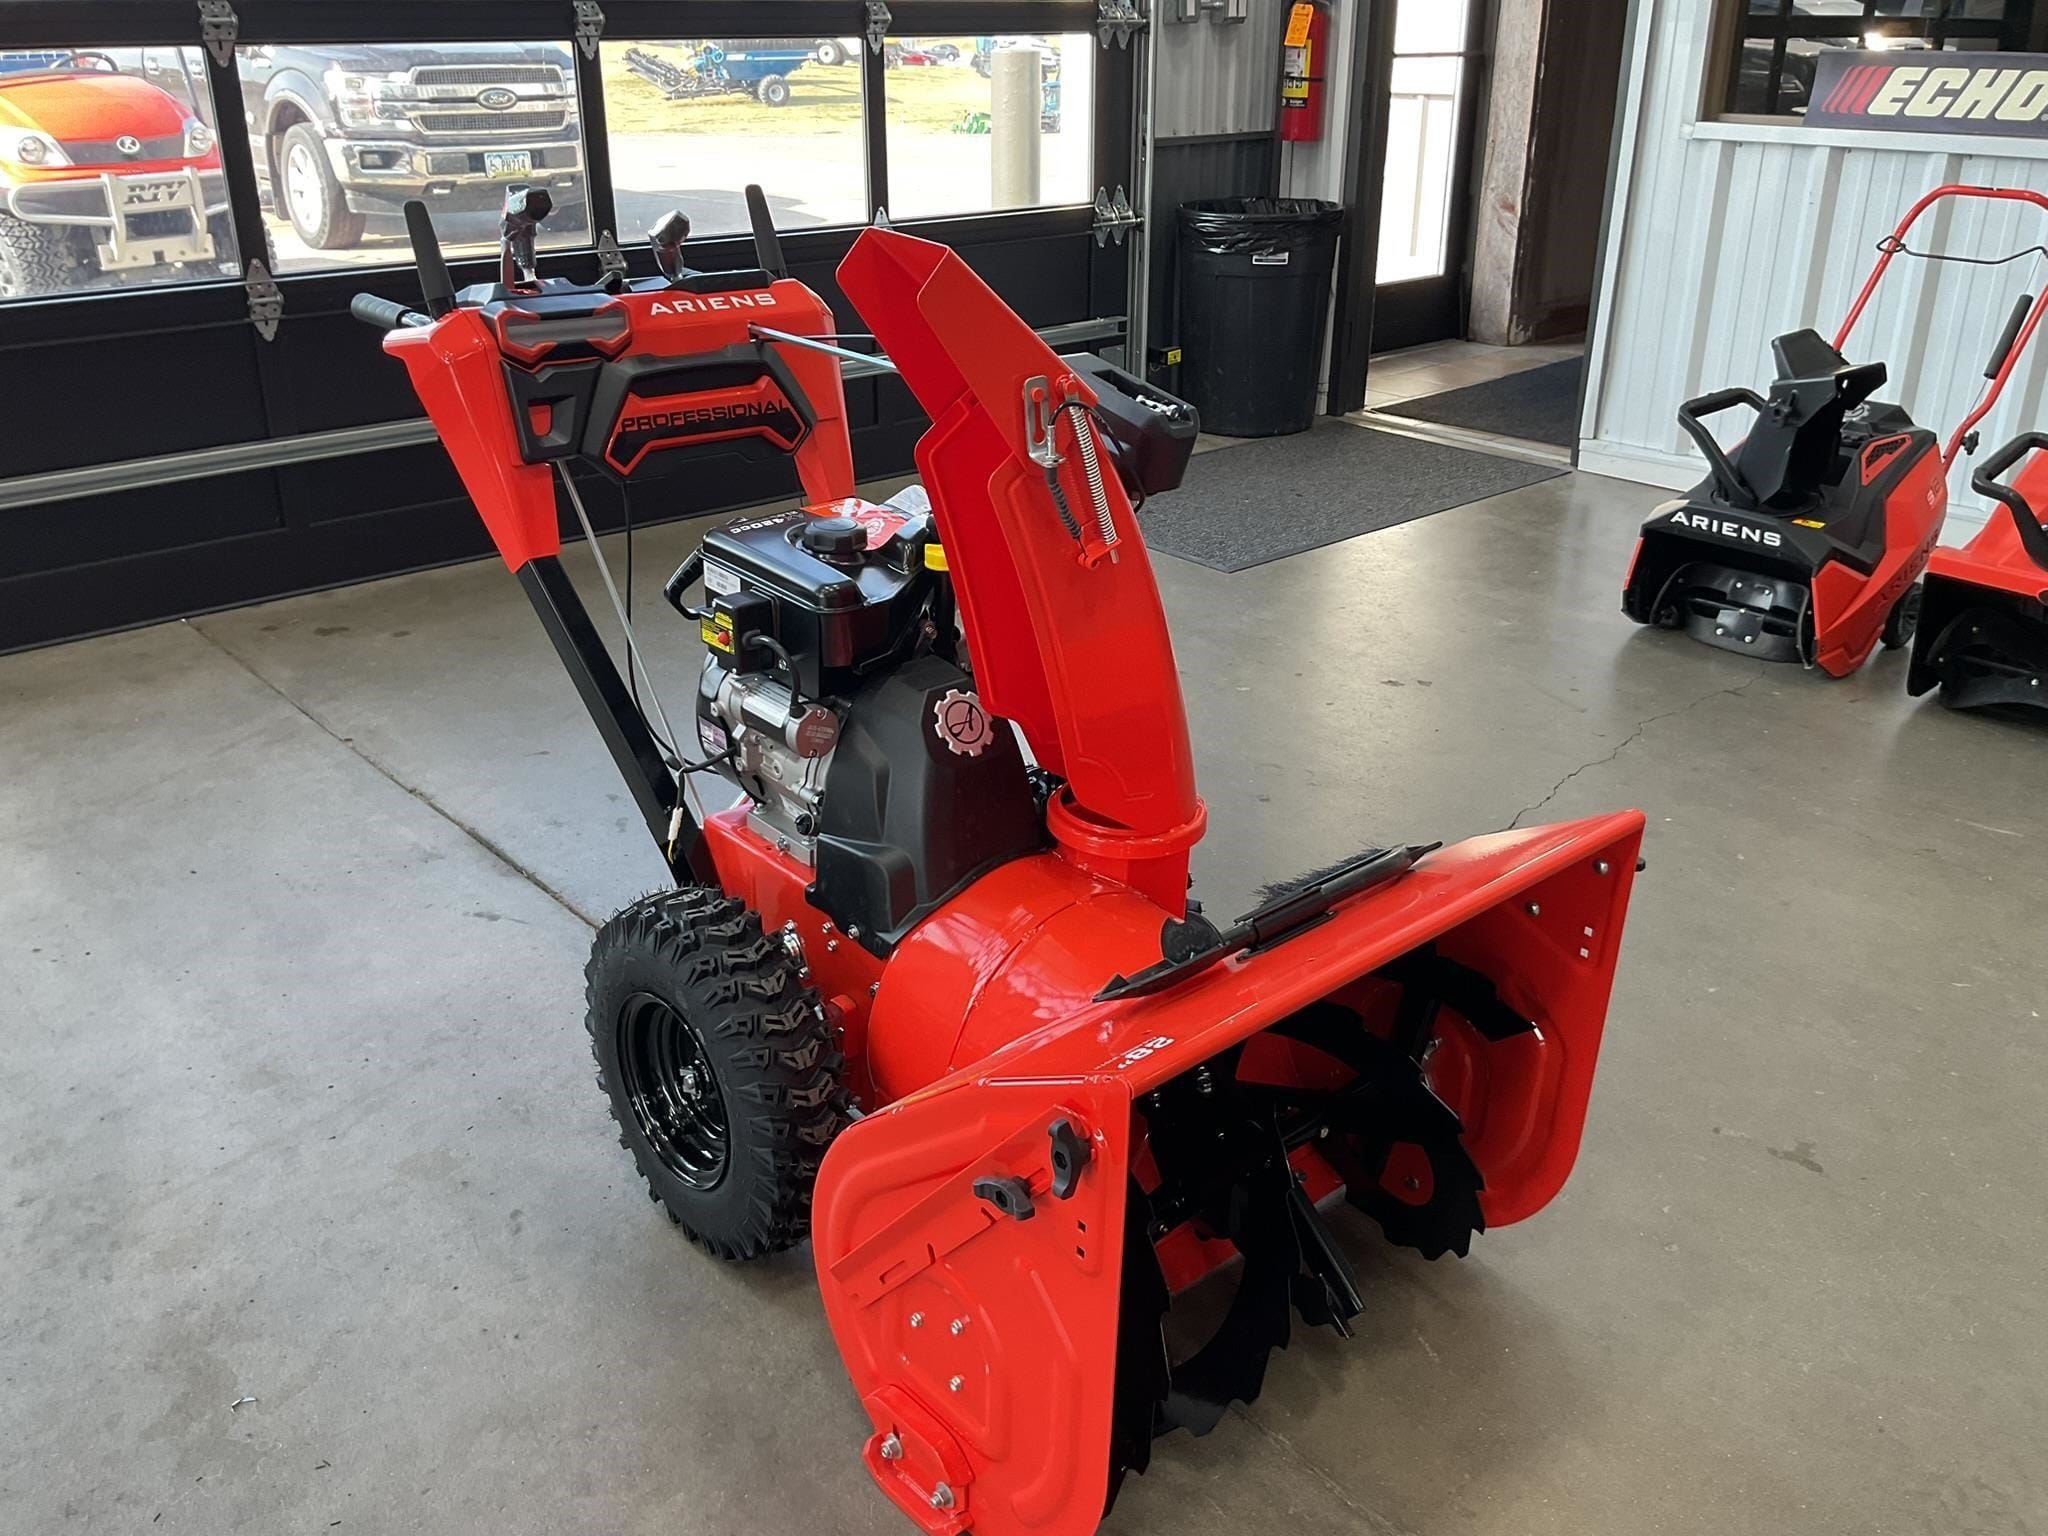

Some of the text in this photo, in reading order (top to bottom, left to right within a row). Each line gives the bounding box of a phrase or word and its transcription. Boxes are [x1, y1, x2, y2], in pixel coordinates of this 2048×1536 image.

[1867, 66, 2048, 121] ECHO
[124, 180, 187, 205] RTV
[650, 293, 777, 317] ARIENS
[620, 399, 785, 433] PROFESSIONAL
[1669, 511, 1782, 547] ARIENS
